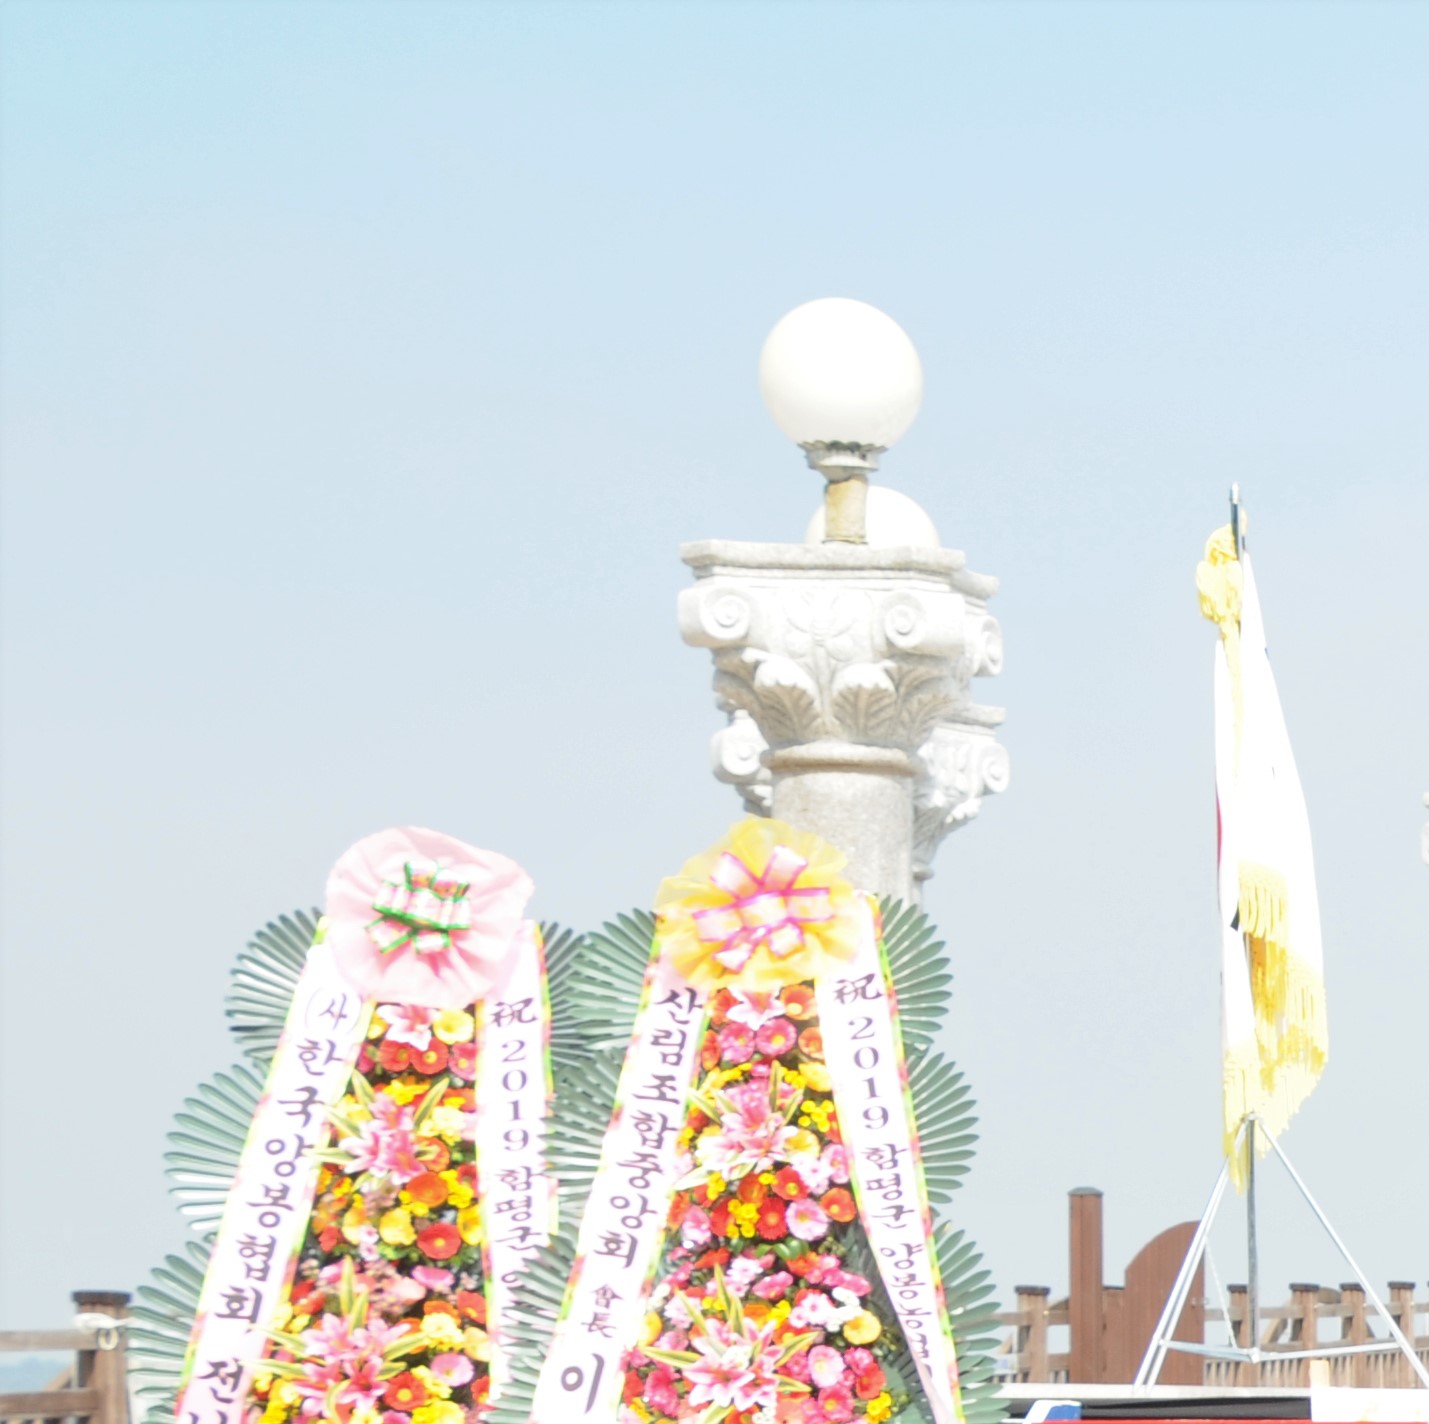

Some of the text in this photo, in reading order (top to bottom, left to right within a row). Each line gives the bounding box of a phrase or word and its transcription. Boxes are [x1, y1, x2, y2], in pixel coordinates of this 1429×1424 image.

[594, 986, 704, 1268] 산림조합중앙회
[493, 1166, 544, 1250] 함평군
[859, 1143, 909, 1232] 함평군
